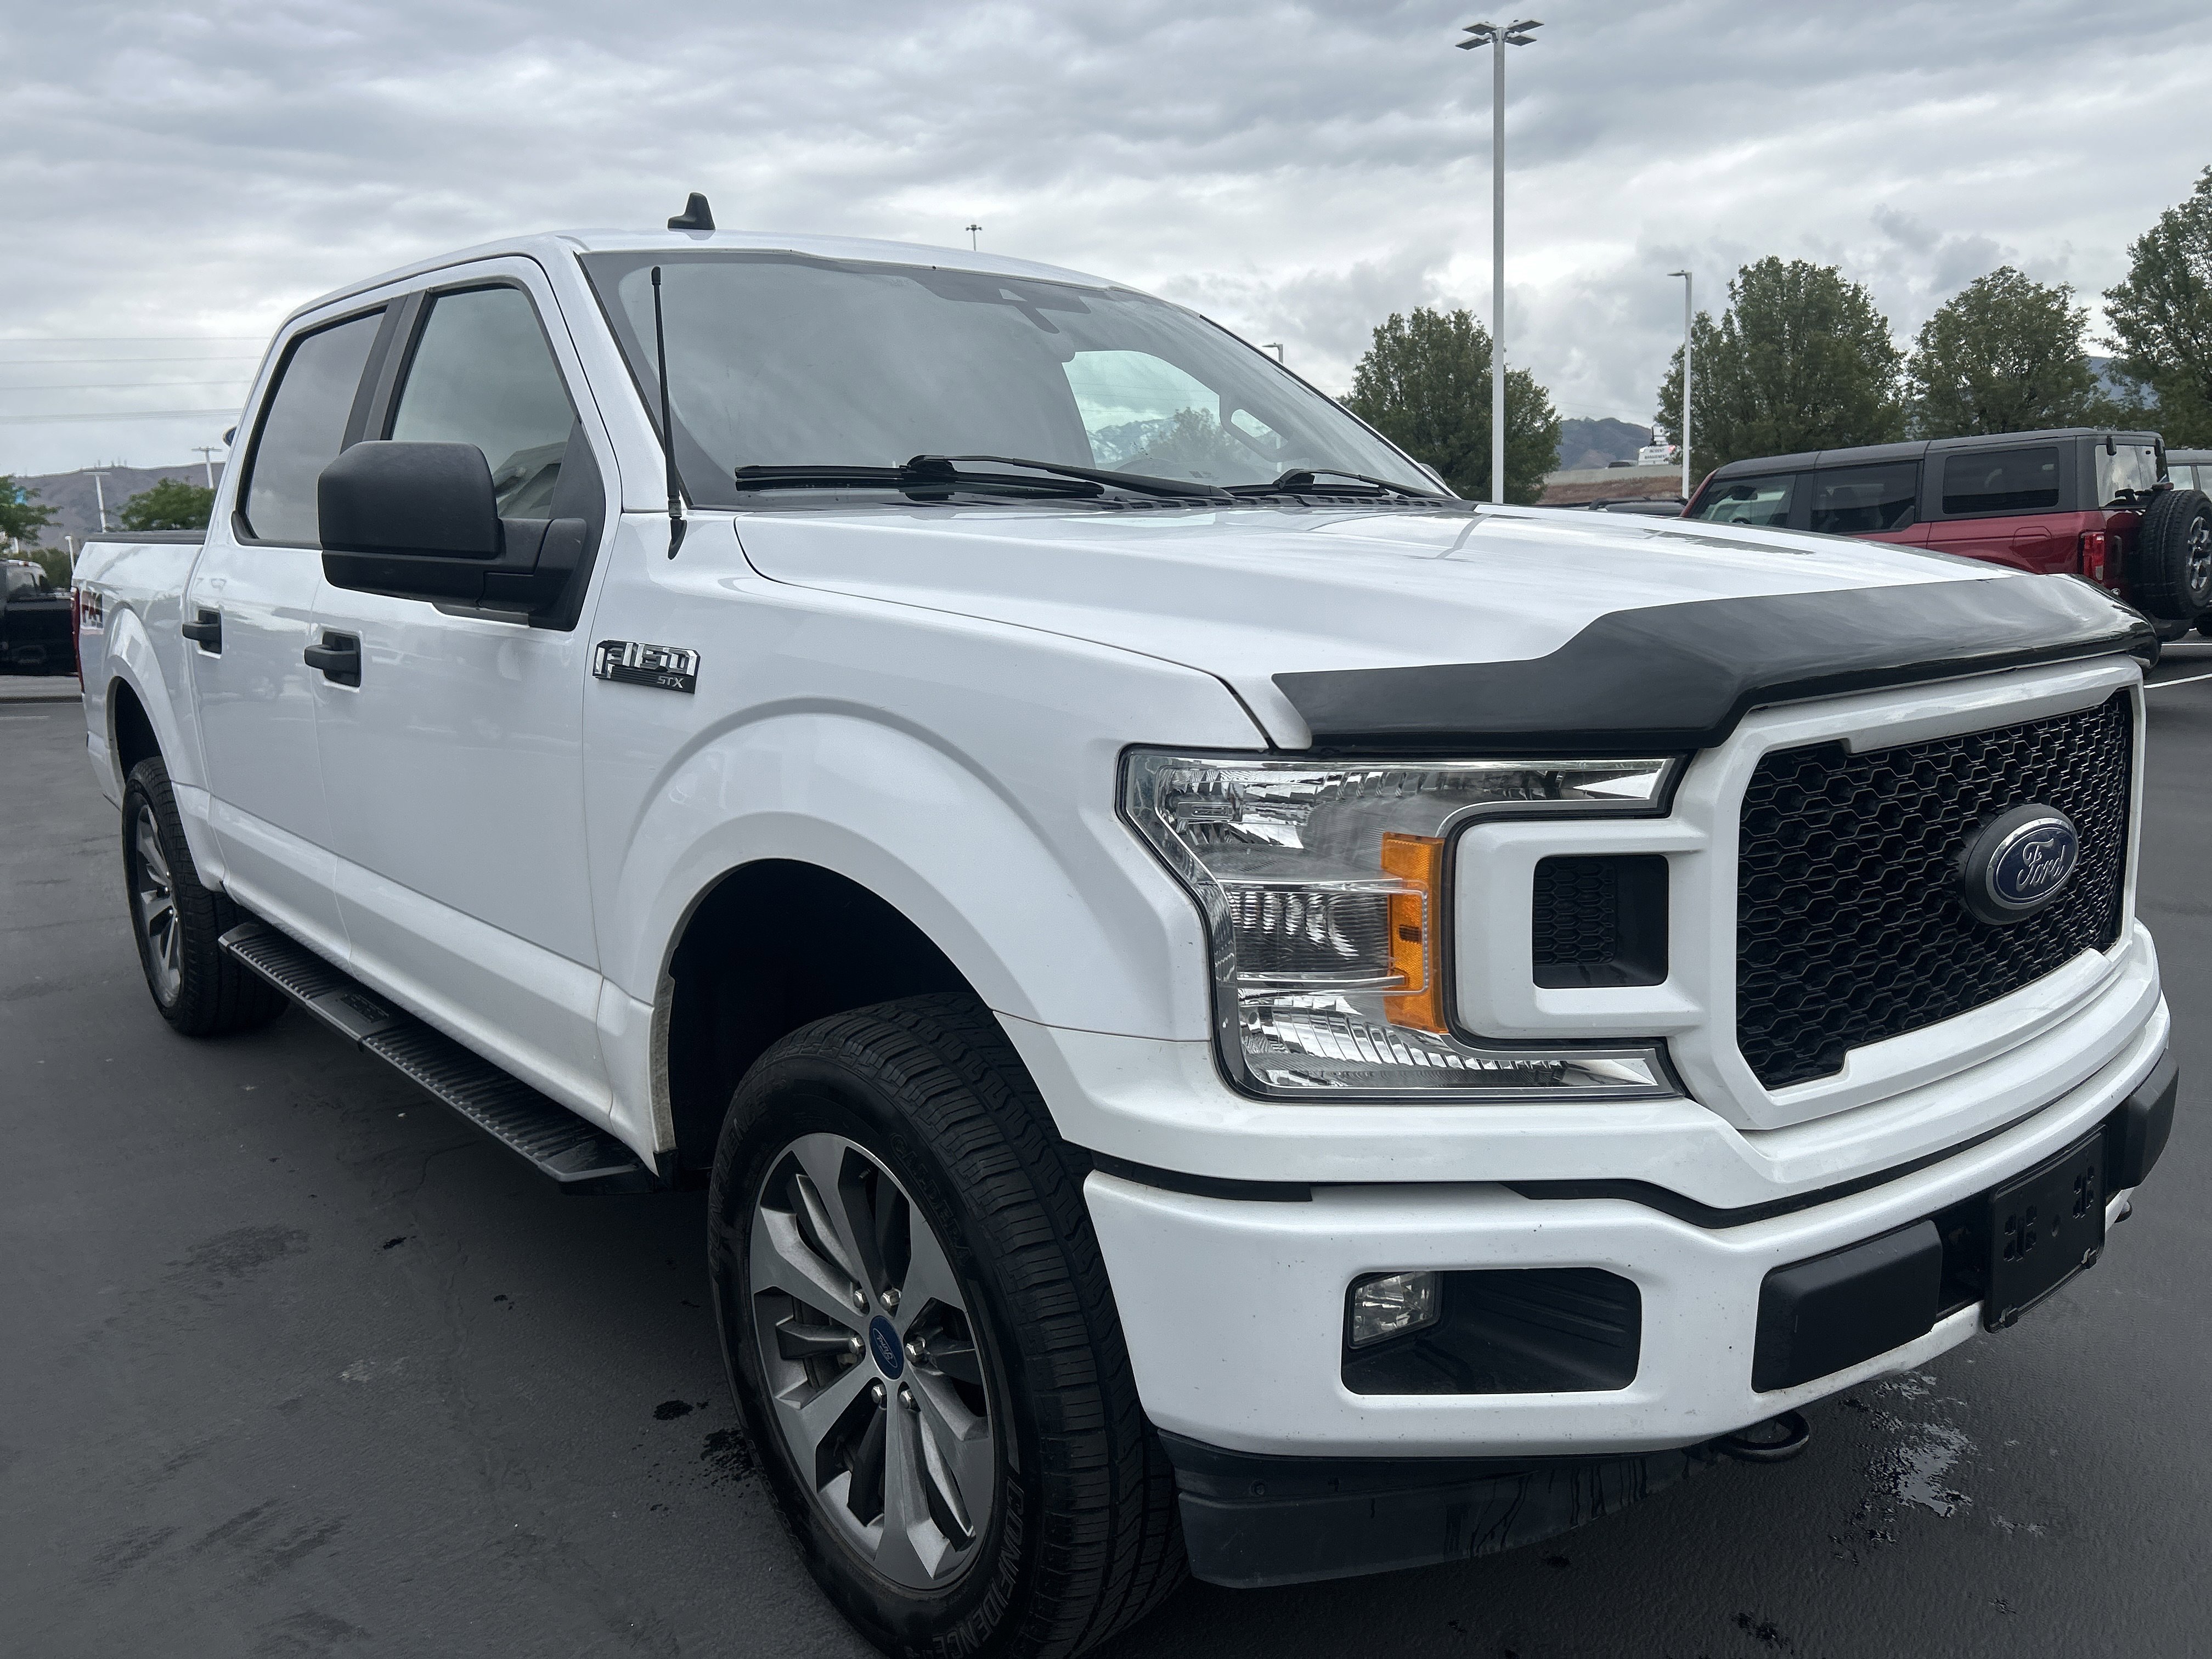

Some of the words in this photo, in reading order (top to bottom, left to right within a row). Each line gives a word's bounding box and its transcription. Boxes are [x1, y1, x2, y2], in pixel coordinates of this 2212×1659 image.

[657, 676, 684, 689] STX
[2016, 838, 2066, 891] Ford
[708, 1086, 768, 1272] CONFIDENCE
[890, 1133, 972, 1266] CALDERA
[877, 1335, 893, 1361] Ford
[932, 1476, 1025, 1659] CONFIDENCE
